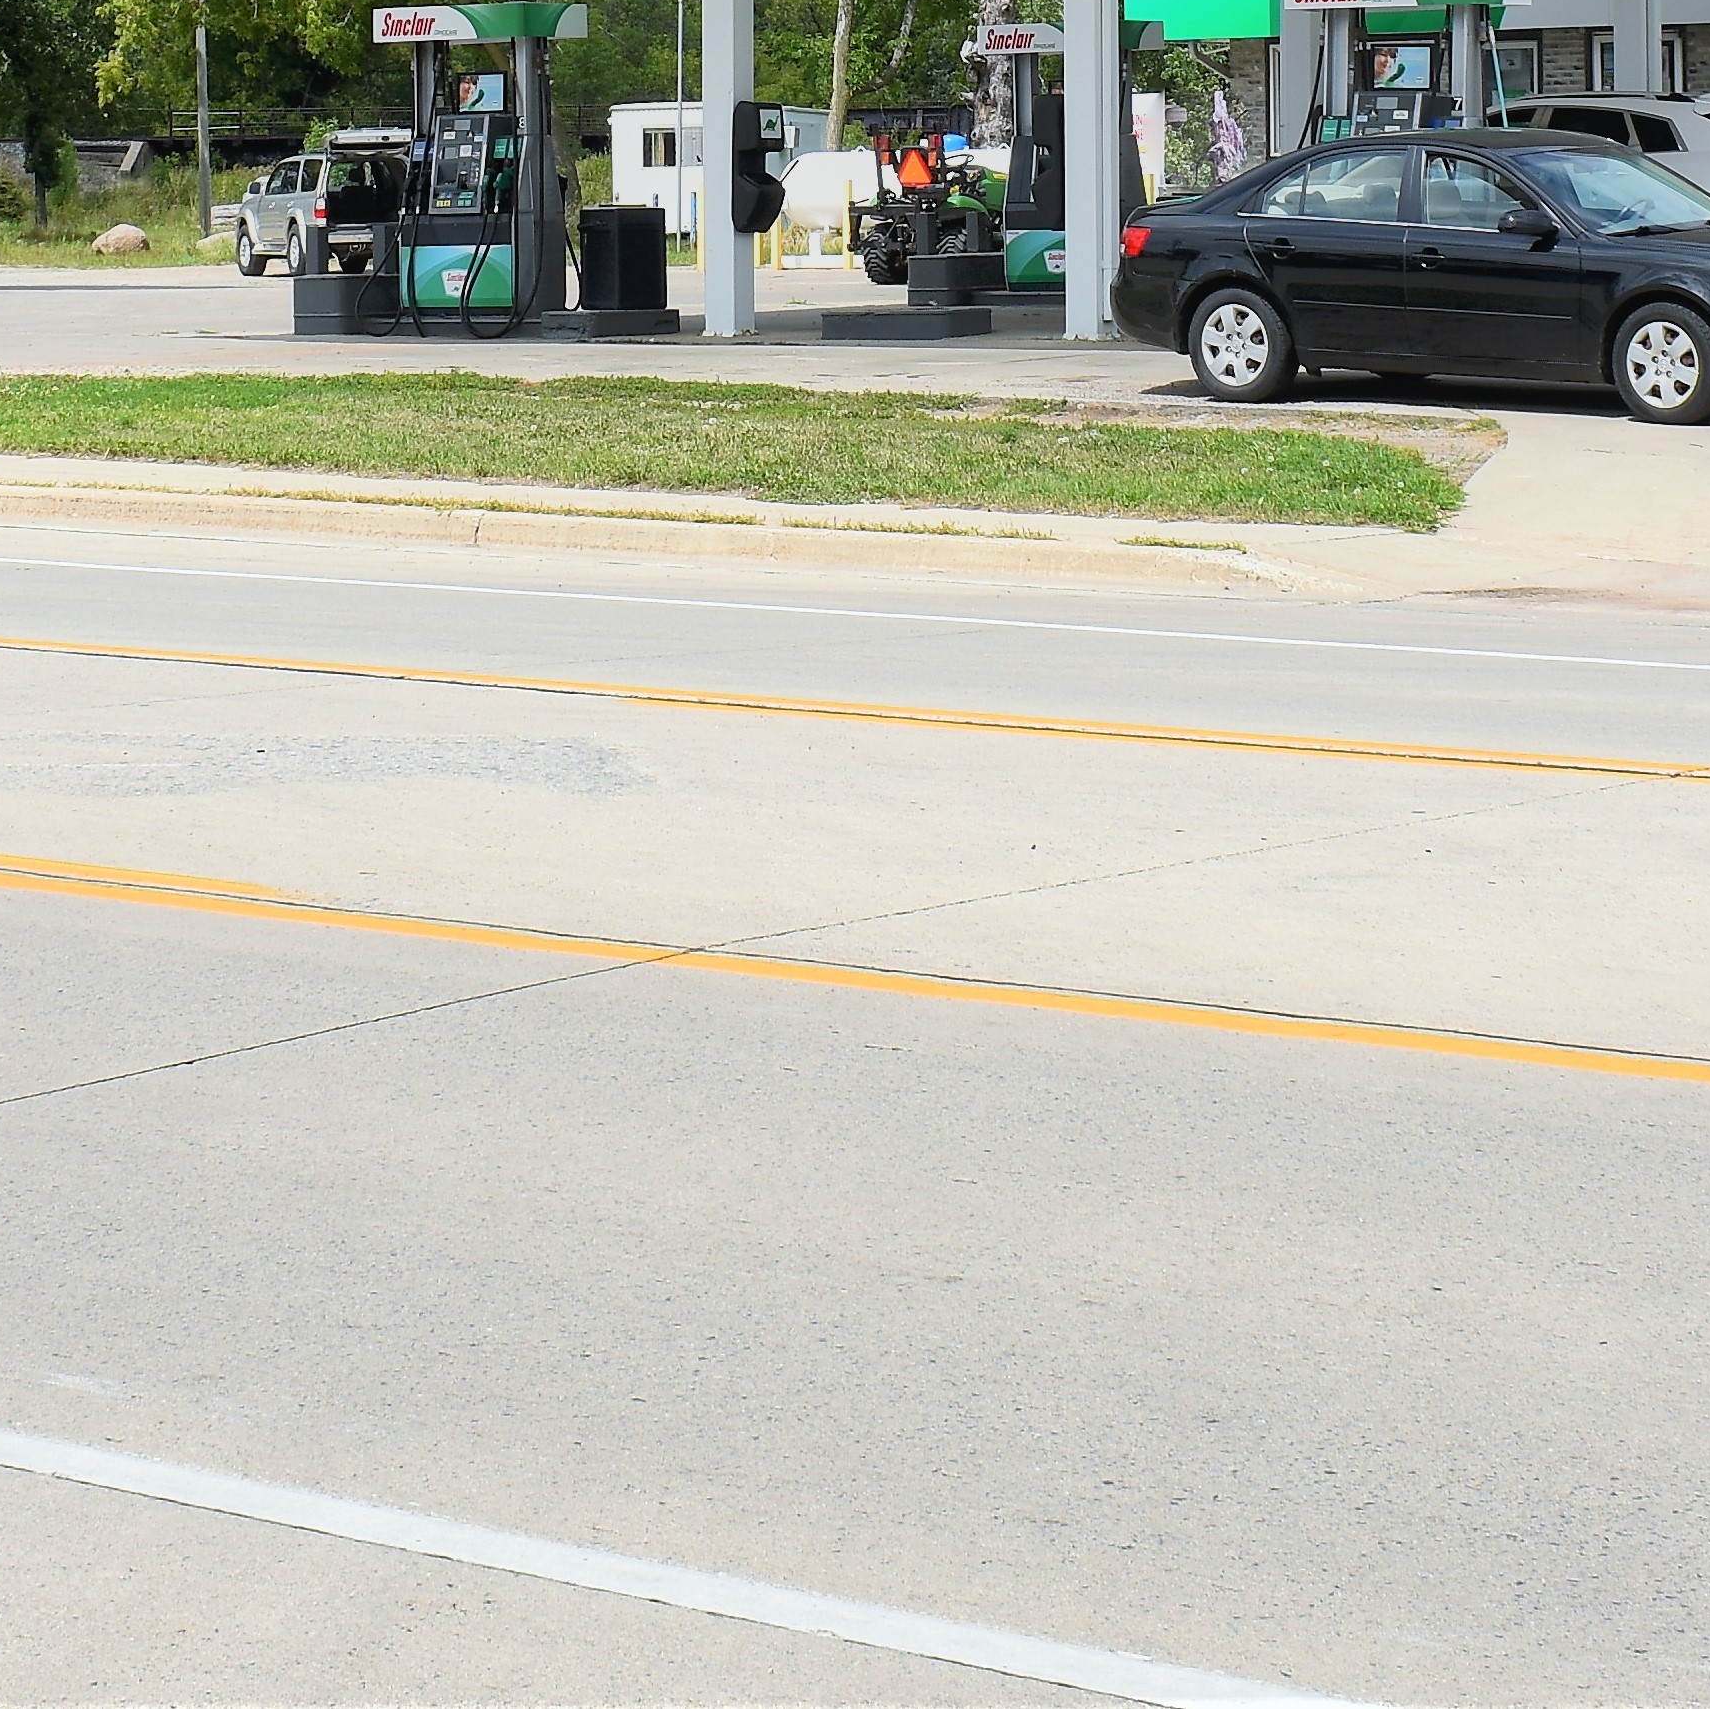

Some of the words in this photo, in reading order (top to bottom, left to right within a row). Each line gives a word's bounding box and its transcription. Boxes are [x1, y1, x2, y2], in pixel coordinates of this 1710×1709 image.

[381, 12, 436, 37] Sinclair
[985, 28, 1035, 50] Sinclair
[1453, 97, 1462, 111] 7
[518, 116, 525, 129] 8
